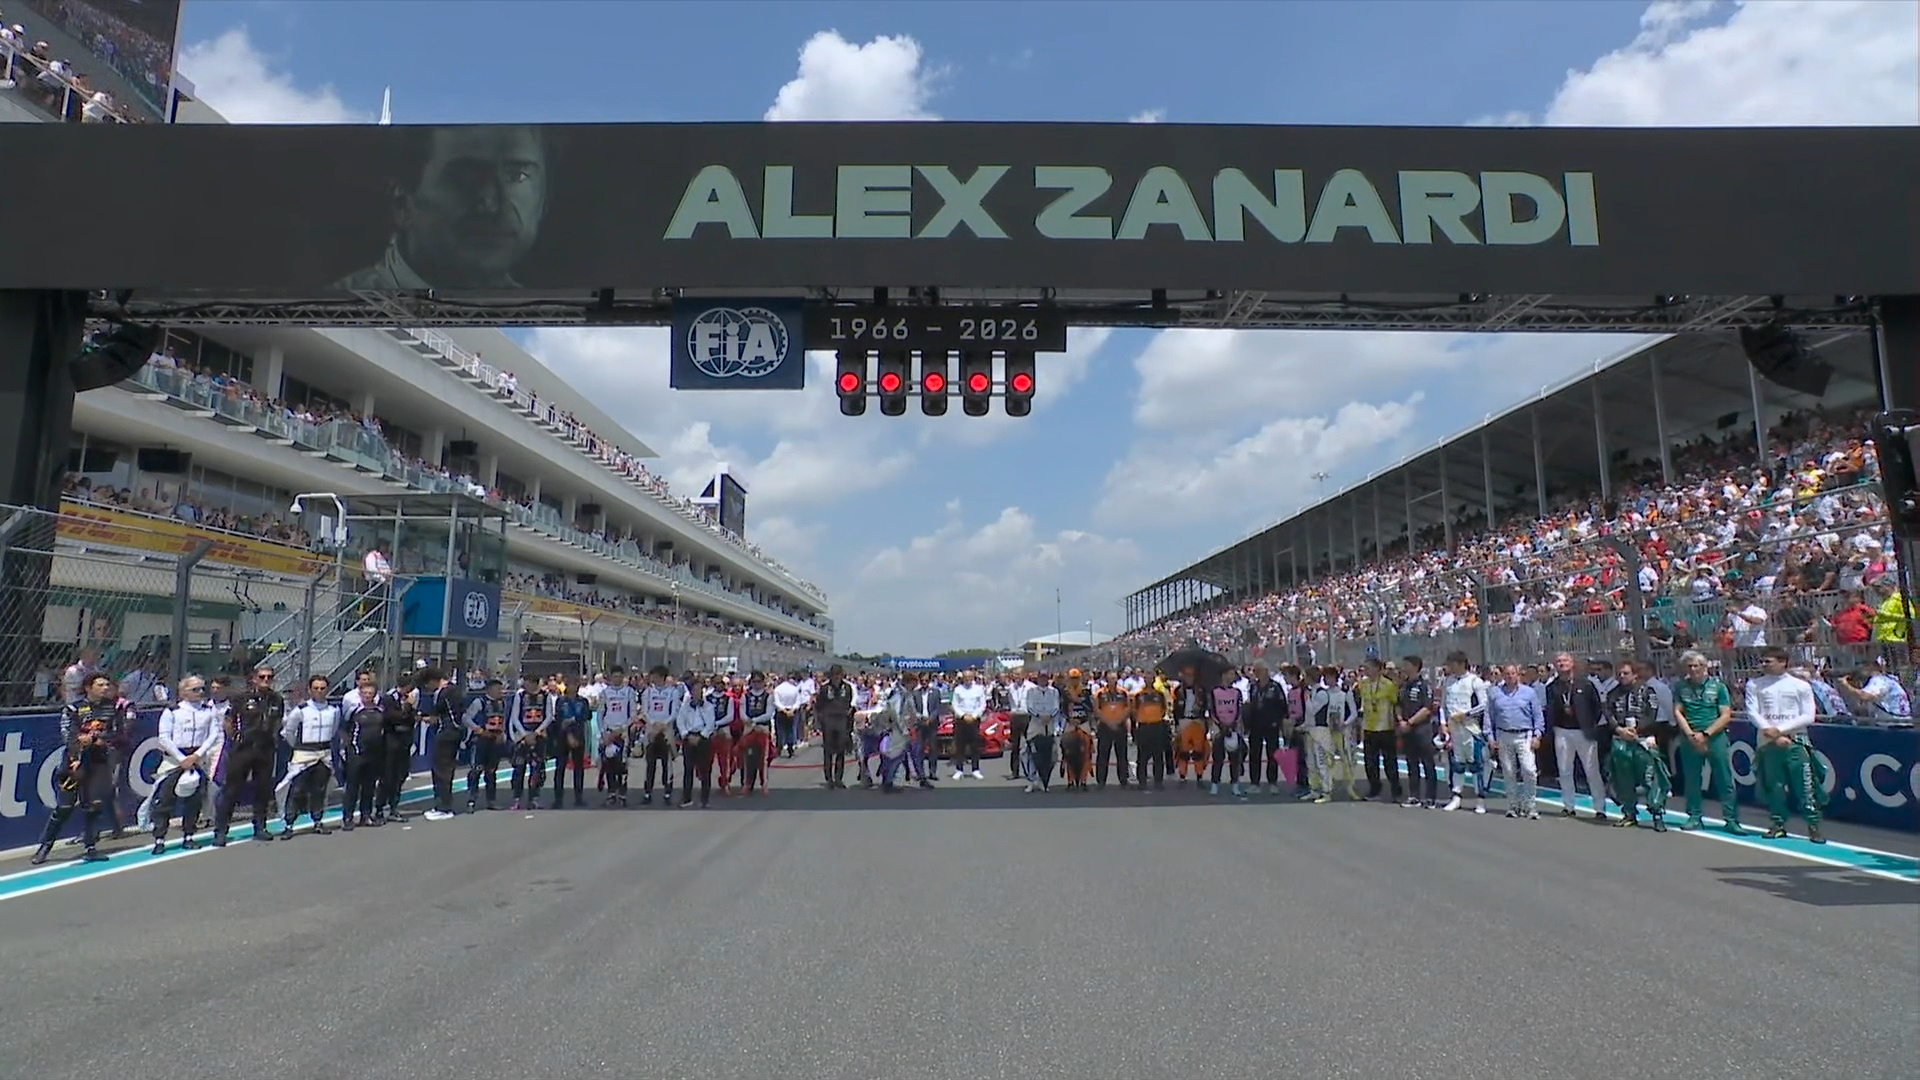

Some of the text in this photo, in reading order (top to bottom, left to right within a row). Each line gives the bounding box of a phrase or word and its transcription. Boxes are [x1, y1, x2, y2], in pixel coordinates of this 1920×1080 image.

[663, 165, 1600, 246] ALEX ZANARDI
[830, 317, 909, 340] 1966
[959, 318, 1038, 340] 2026
[898, 661, 939, 669] crypto.com
